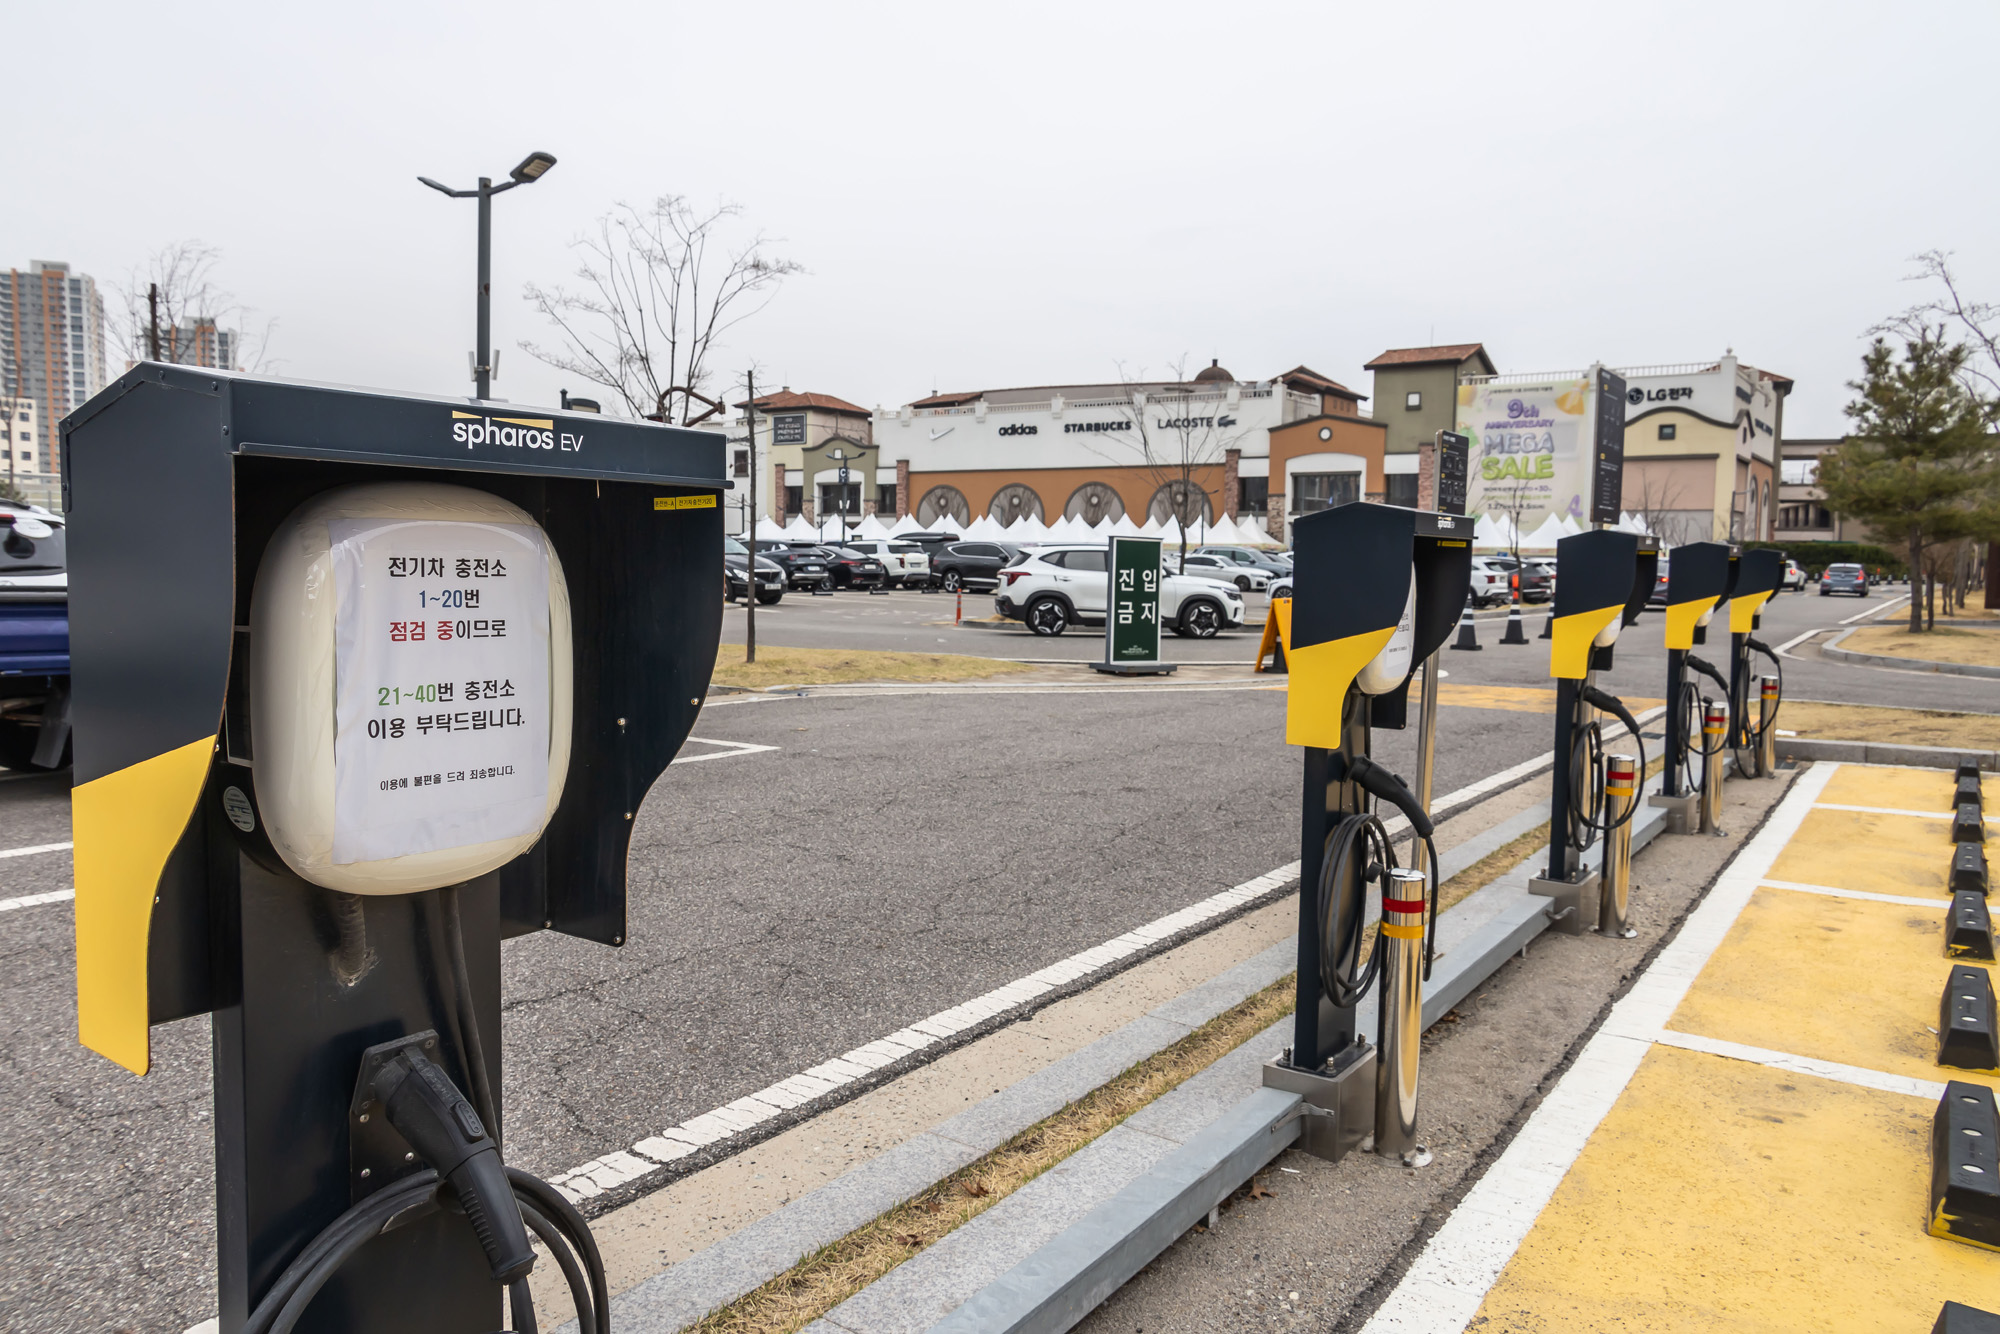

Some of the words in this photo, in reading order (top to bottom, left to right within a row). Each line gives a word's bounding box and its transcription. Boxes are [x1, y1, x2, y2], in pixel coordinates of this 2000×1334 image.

[1647, 387, 1693, 402] LG전자
[1507, 398, 1540, 419] 9th
[999, 423, 1038, 436] adidas
[1064, 421, 1131, 434] STARBUCKS
[1157, 417, 1213, 430] LACOSTE
[1485, 419, 1555, 430] ANNIVERSARY
[453, 417, 554, 450] spharos
[561, 433, 583, 452] EV
[1484, 432, 1555, 456] MEGA
[840, 468, 846, 477] C
[1481, 454, 1555, 480] SALE
[388, 557, 445, 578] 전기차
[455, 558, 507, 578] 충전소
[419, 589, 480, 608] 1~20번
[389, 621, 426, 642] 점검
[437, 619, 507, 641] 중이므로
[378, 682, 453, 706] 21~40번
[464, 679, 515, 701] 충전소
[367, 717, 406, 739] 이용
[416, 707, 525, 735] 부탁드립니다.
[380, 777, 408, 791] 이용에
[414, 773, 442, 787] 불편을
[447, 770, 465, 783] 드려
[469, 765, 515, 780] 죄송합니다.
